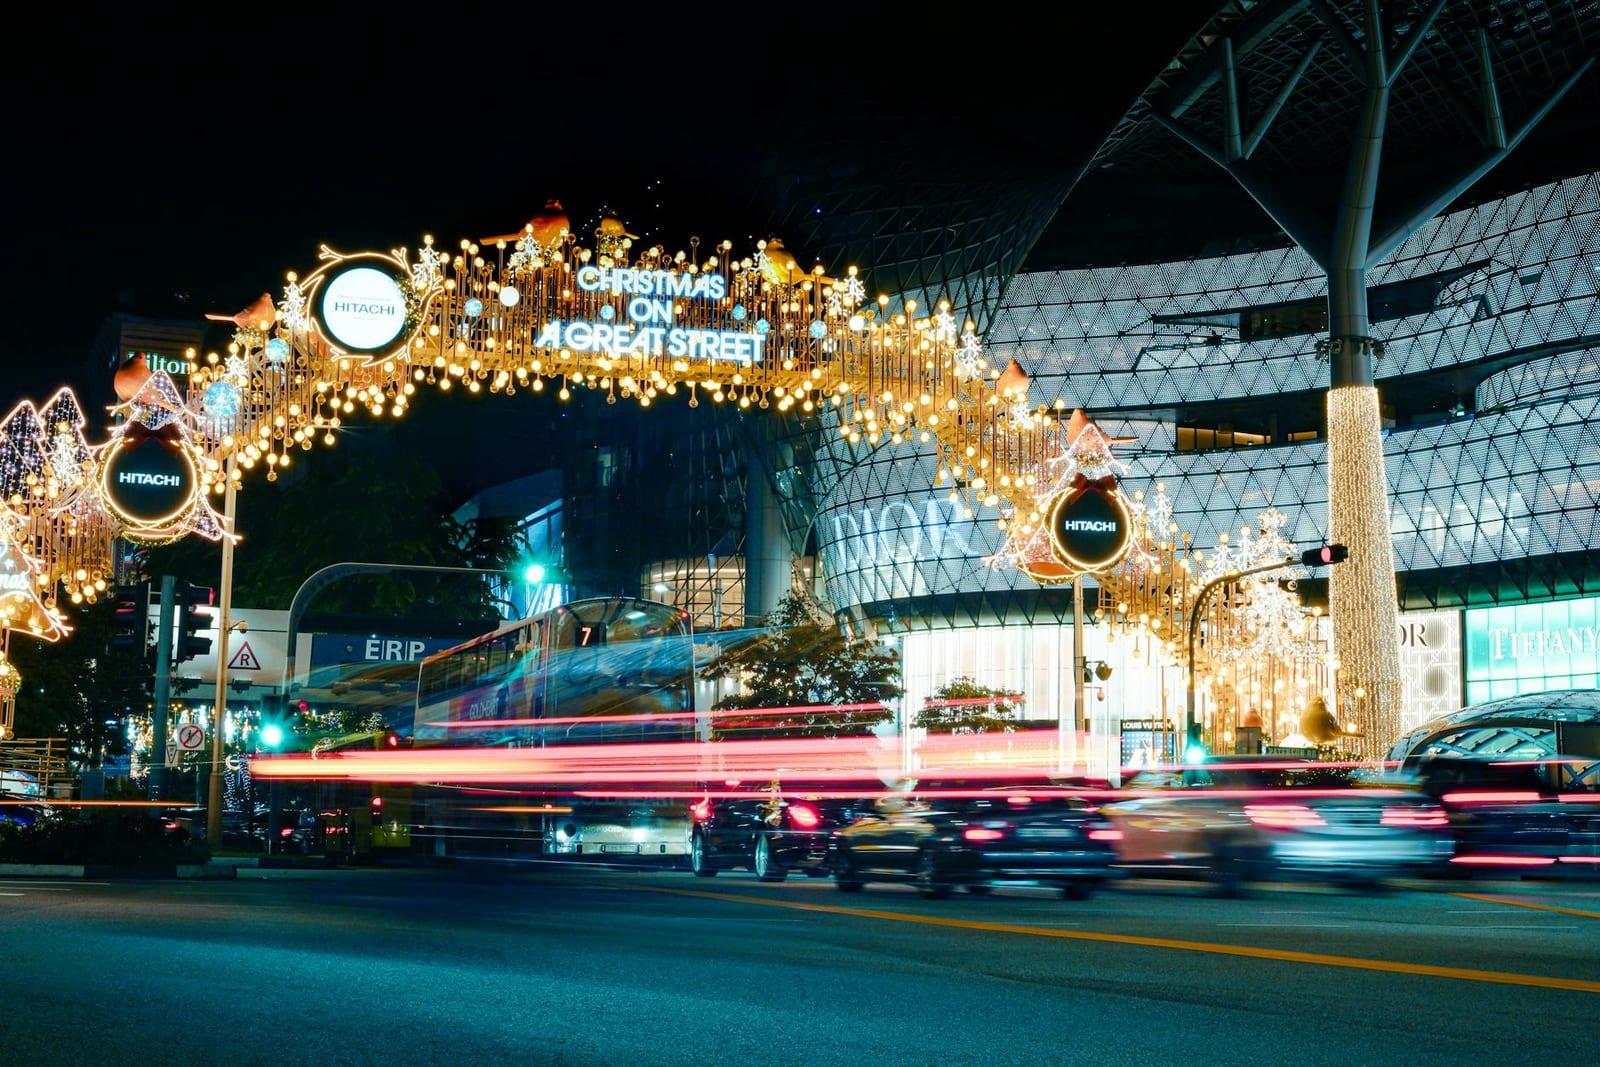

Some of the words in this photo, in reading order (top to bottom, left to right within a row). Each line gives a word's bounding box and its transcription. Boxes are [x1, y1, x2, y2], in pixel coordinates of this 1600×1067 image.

[577, 265, 725, 299] CHRISTMAS
[334, 301, 395, 316] HITACHI
[628, 298, 673, 324] ON
[535, 321, 561, 349] A
[564, 321, 666, 356] GREAT
[668, 327, 766, 362] STREET
[128, 351, 193, 375] ilton
[119, 472, 180, 487] HITACHI
[1065, 520, 1117, 532] HITACHI
[581, 626, 592, 646] 7
[240, 653, 250, 666] R
